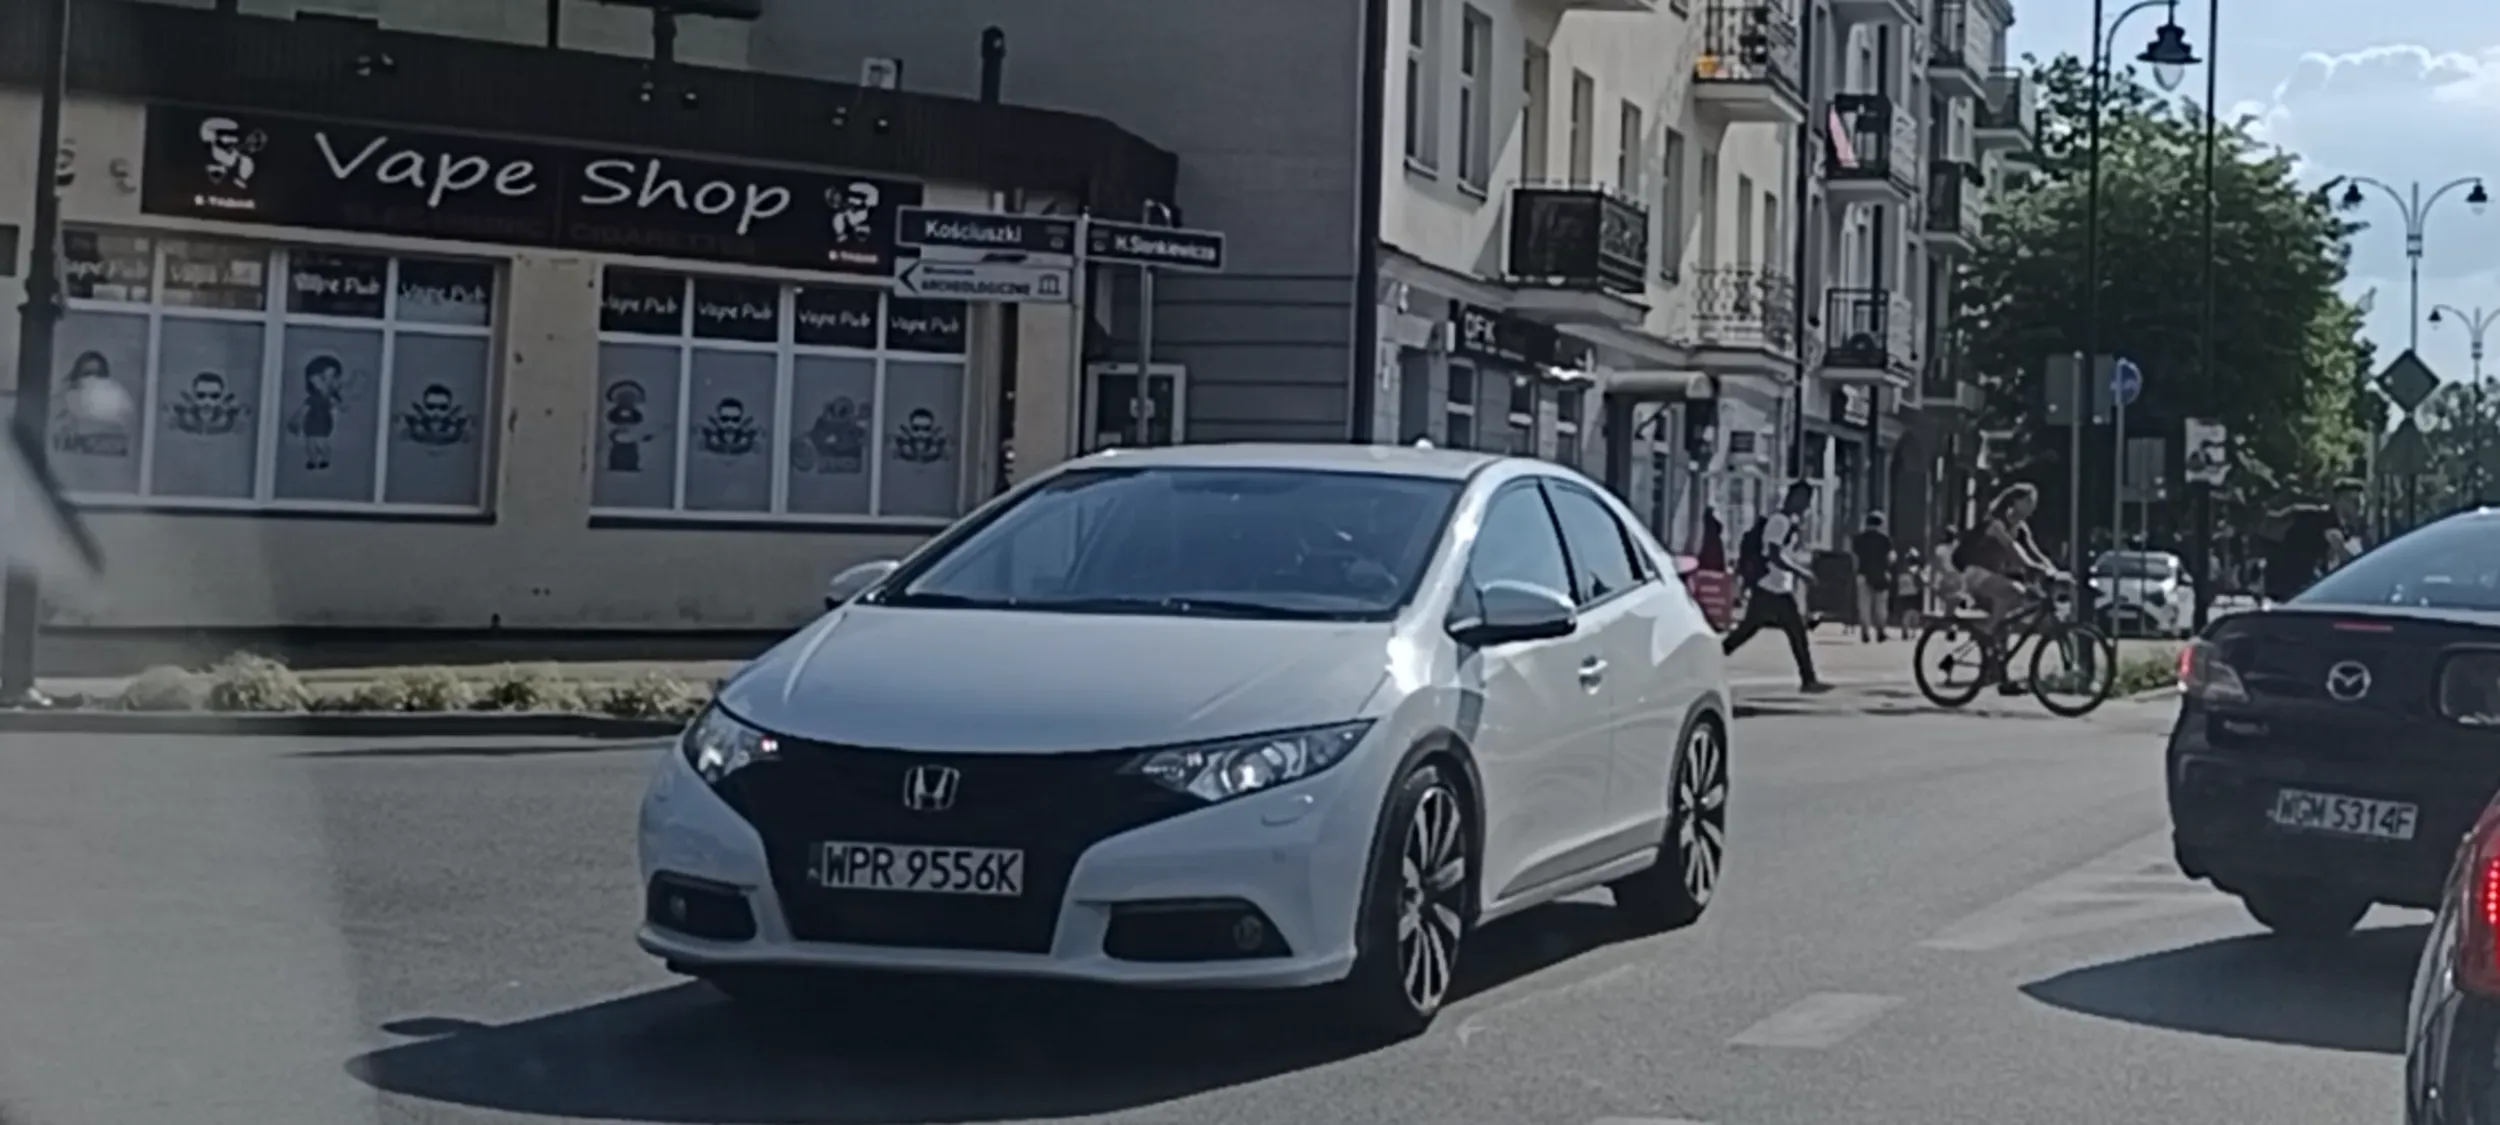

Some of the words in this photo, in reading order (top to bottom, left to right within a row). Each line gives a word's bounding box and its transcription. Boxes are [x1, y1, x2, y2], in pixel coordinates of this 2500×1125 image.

[314, 131, 537, 207] Vape
[581, 159, 791, 235] Shop
[925, 219, 1022, 243] Kościuszki
[344, 275, 384, 296] Pub
[644, 294, 678, 315] Pub
[698, 299, 738, 324] Vape
[742, 300, 773, 321] Pub
[798, 307, 836, 331] Vape
[840, 309, 871, 329] Pub
[891, 315, 927, 337] Vape
[930, 315, 960, 334] Pub
[2332, 798, 2414, 834] 5314F
[825, 845, 895, 887] WPR
[907, 850, 1019, 892] 9556K
